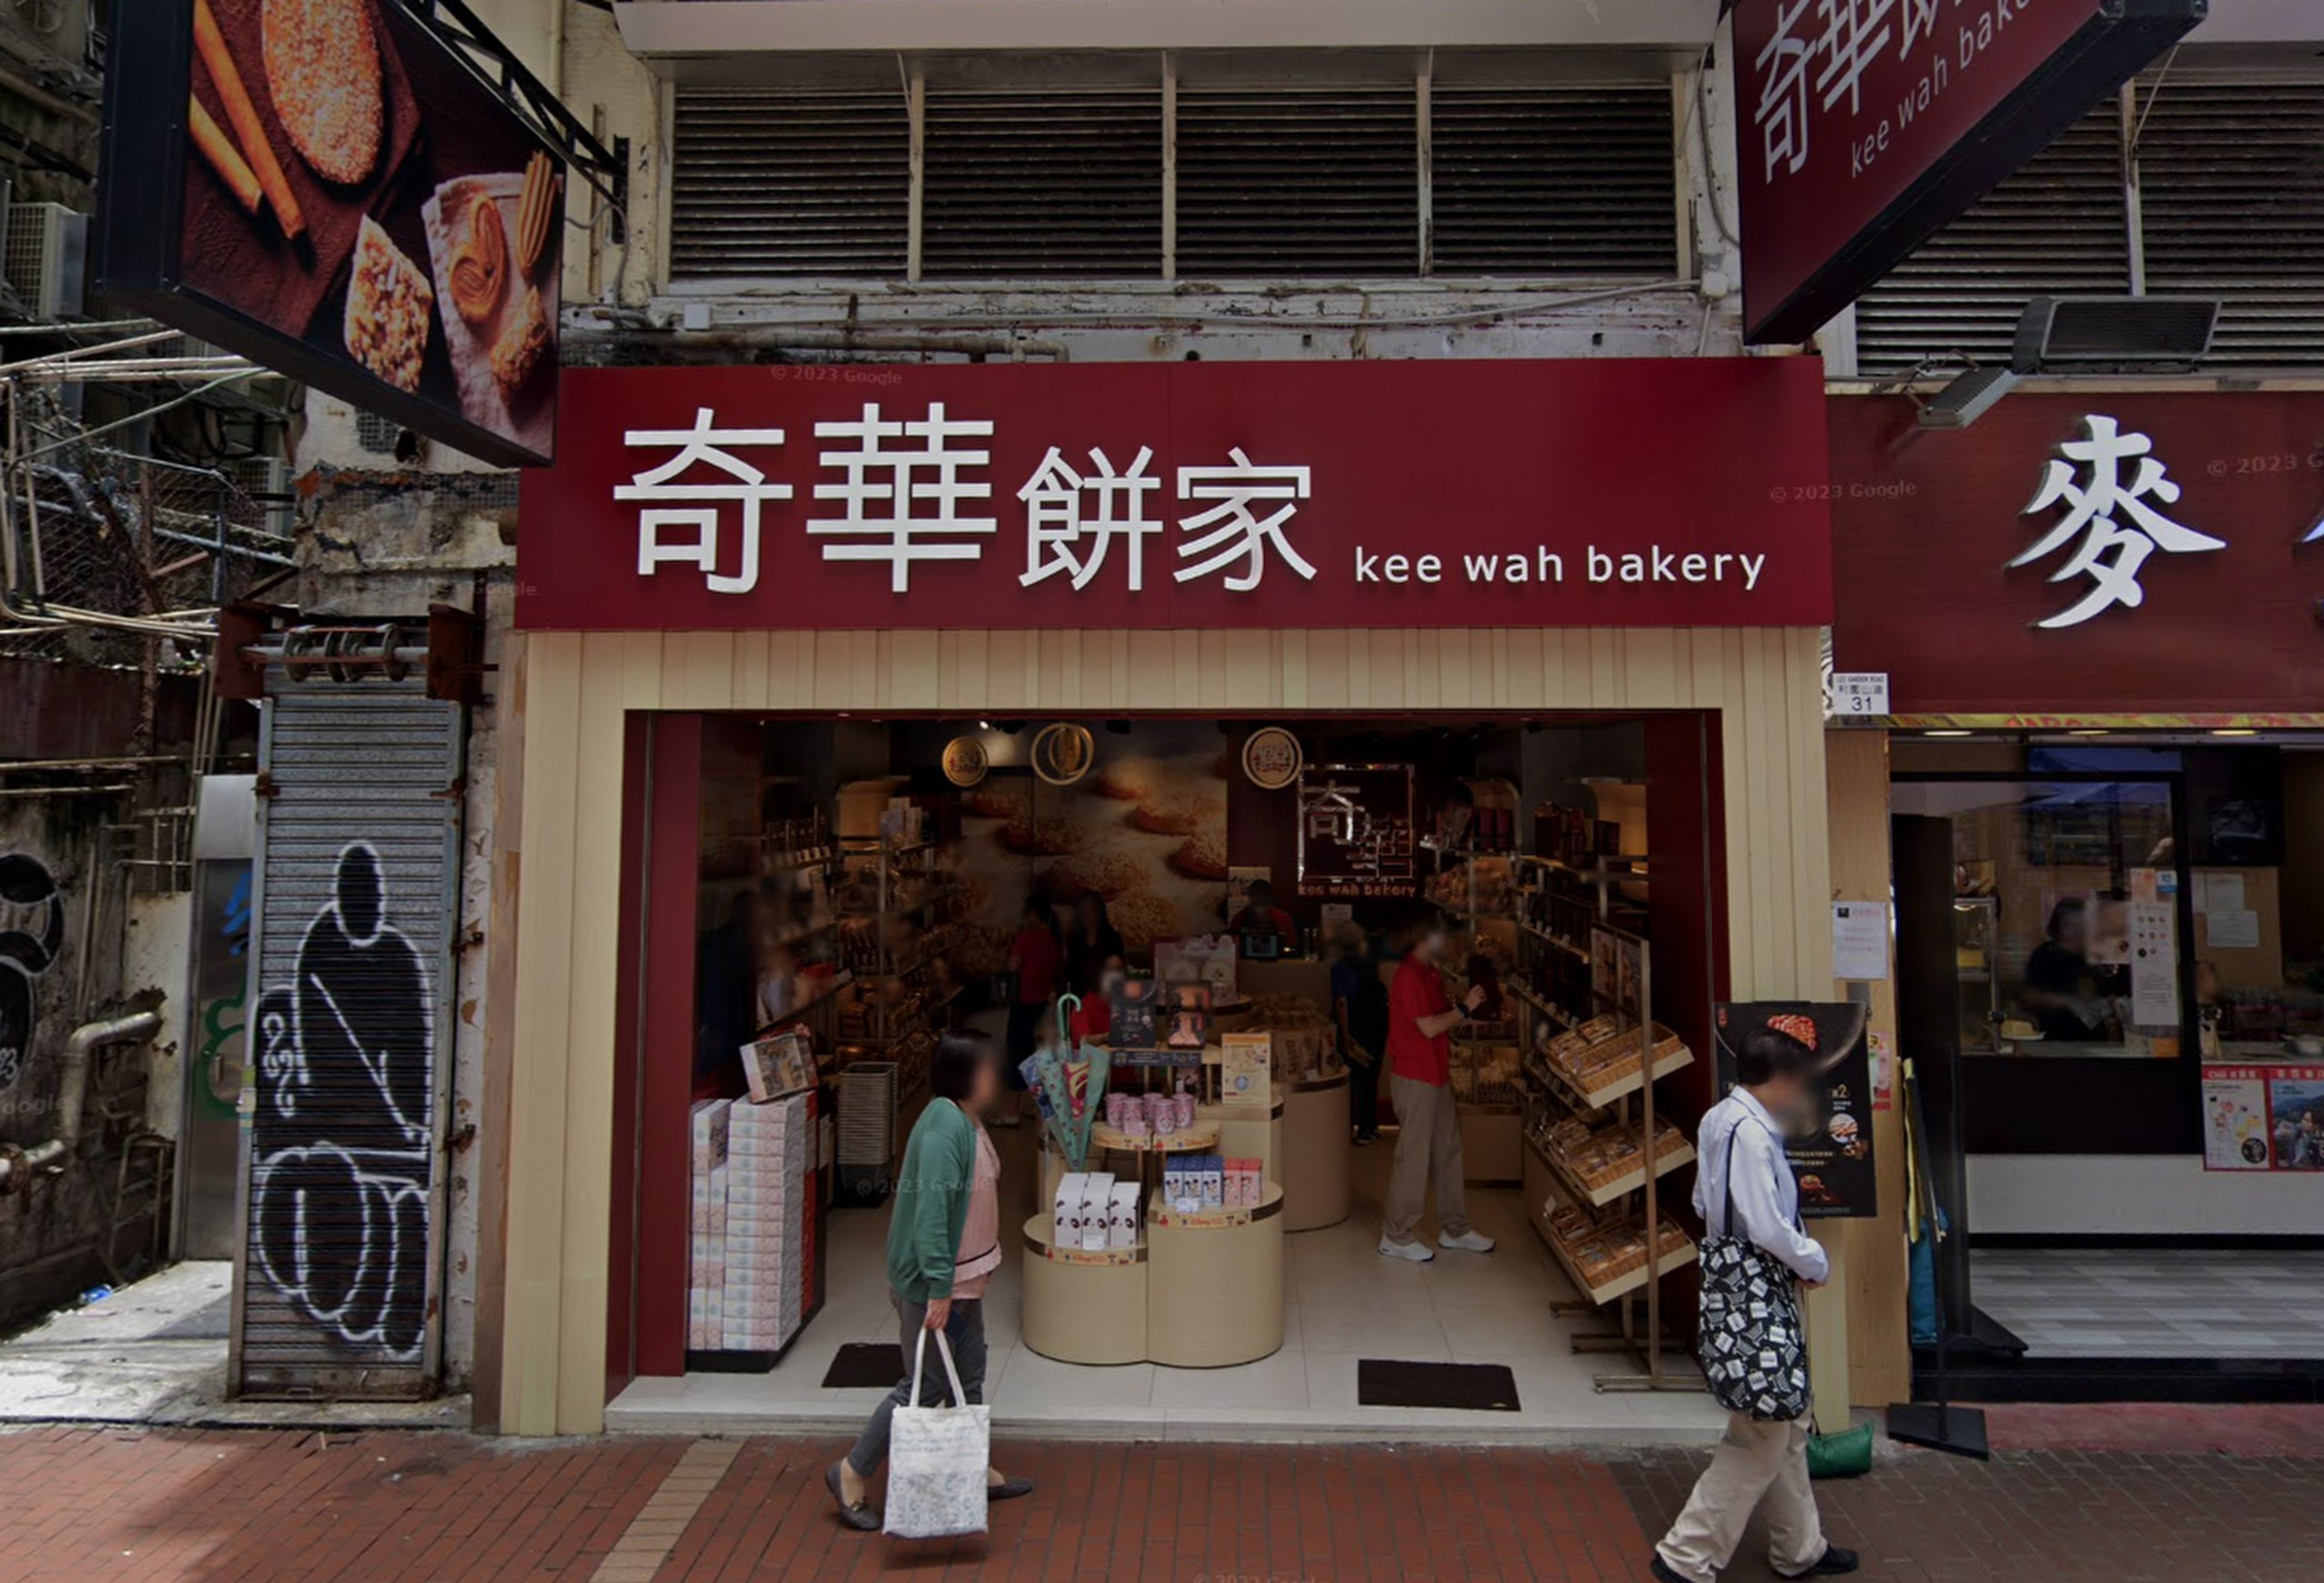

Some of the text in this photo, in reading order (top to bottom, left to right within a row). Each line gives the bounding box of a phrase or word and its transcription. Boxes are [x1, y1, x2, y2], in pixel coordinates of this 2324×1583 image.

[1755, 0, 1939, 184] 奇華
[1852, 0, 2030, 179] kee wah bak
[612, 402, 1317, 595] 奇華餅家
[1355, 545, 1767, 591] kee wah bakery
[2006, 414, 2324, 628] 麥
[1851, 696, 1872, 711] 31
